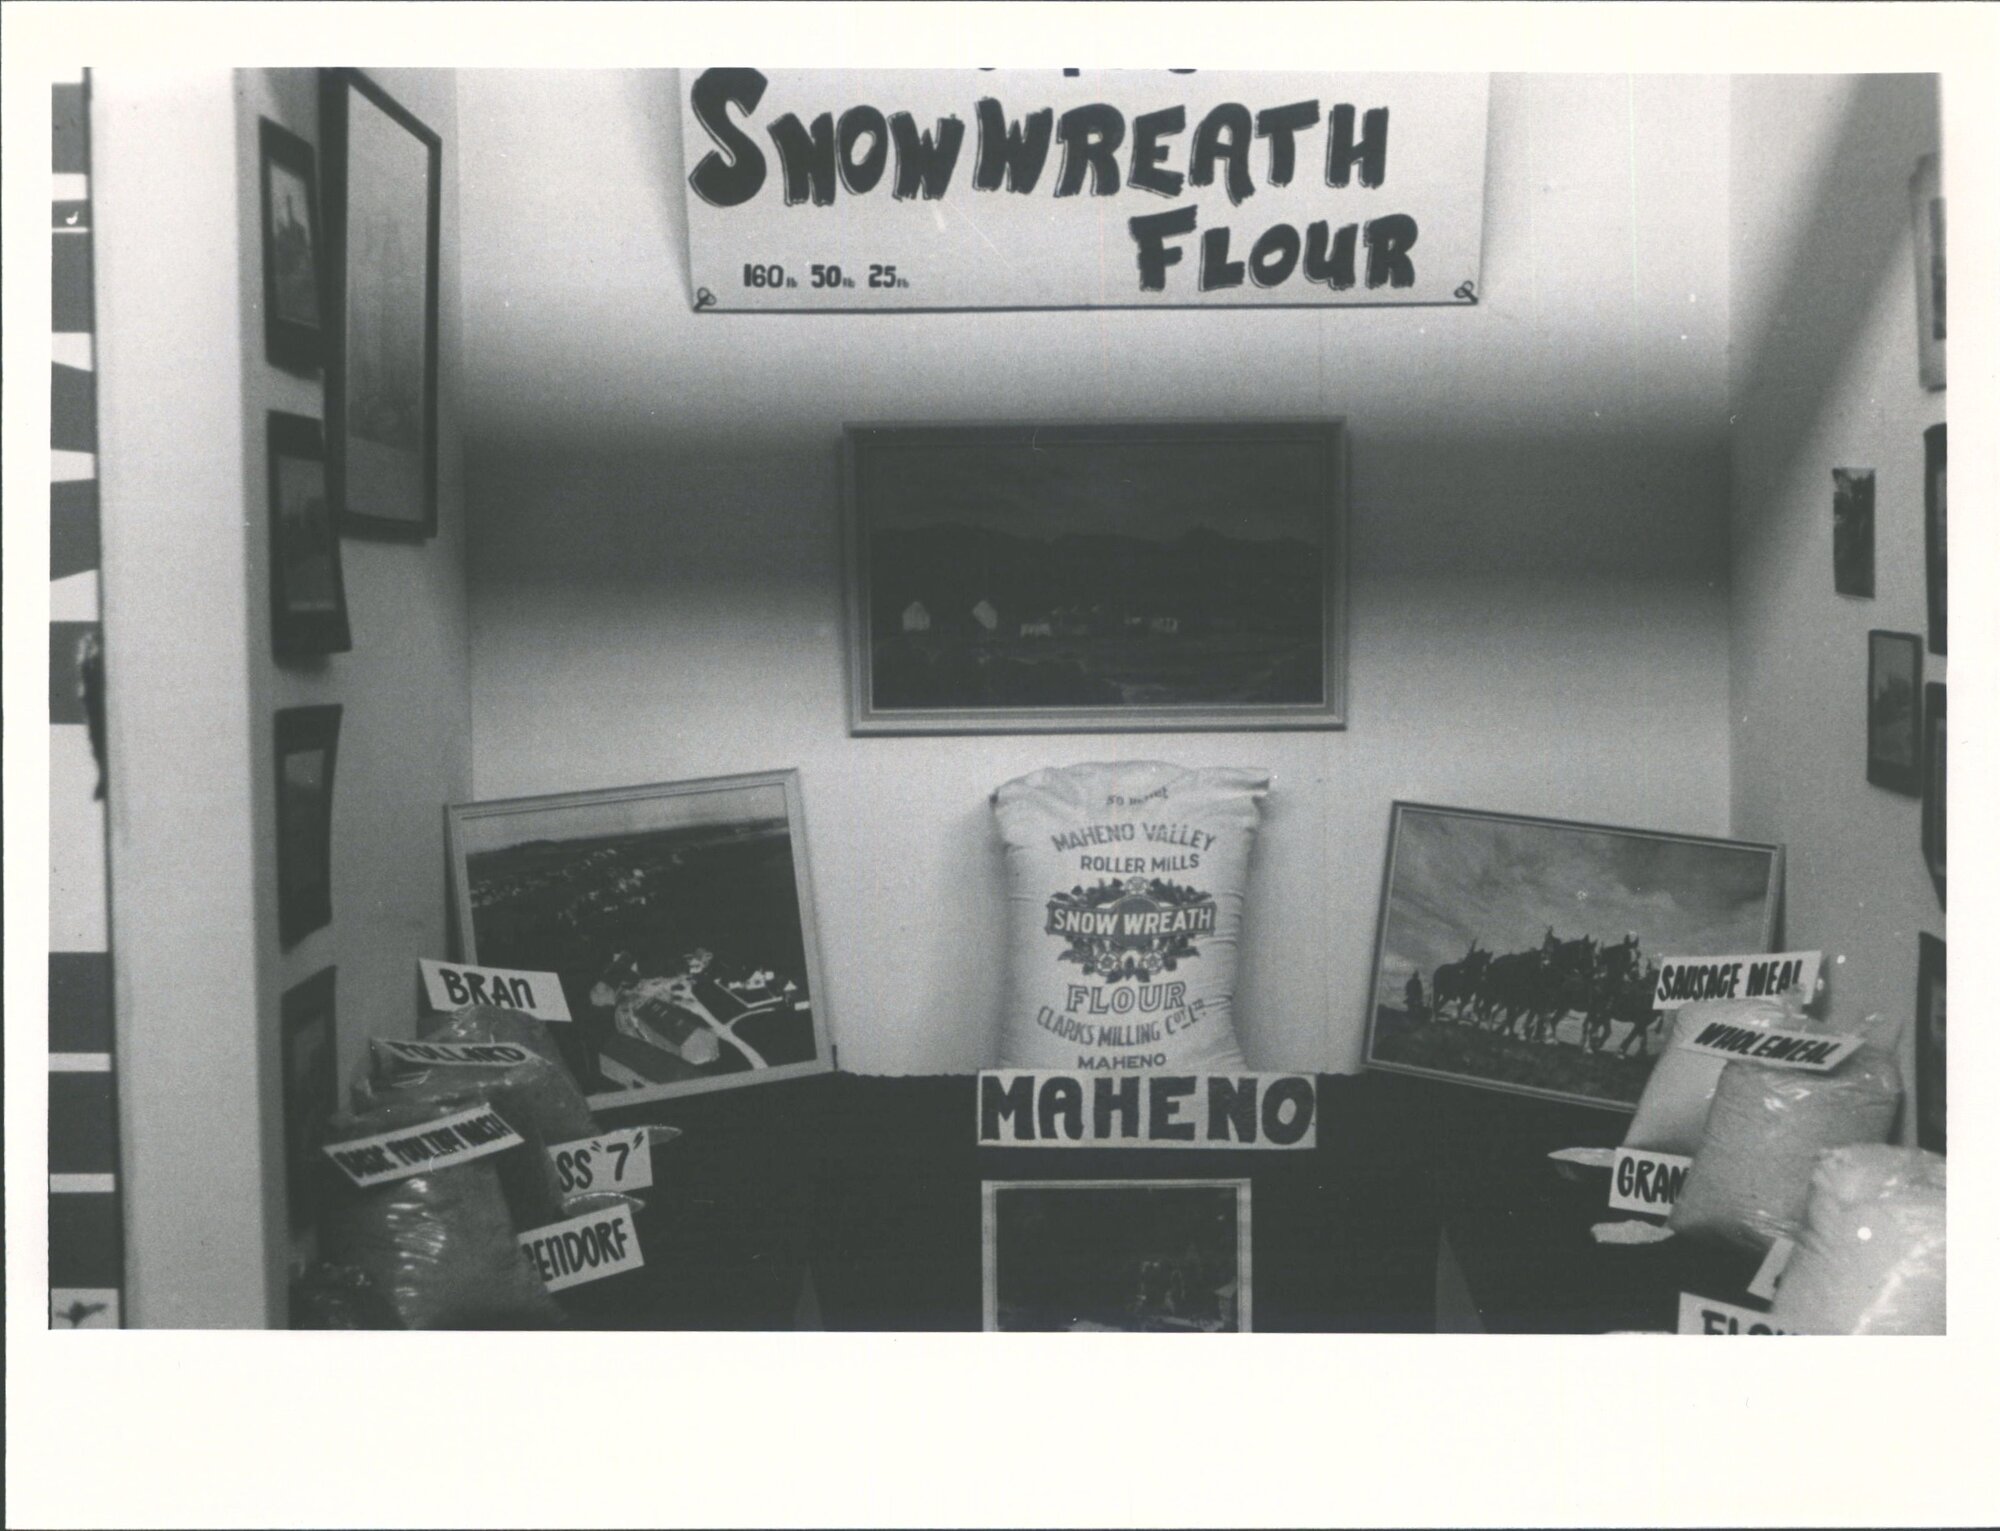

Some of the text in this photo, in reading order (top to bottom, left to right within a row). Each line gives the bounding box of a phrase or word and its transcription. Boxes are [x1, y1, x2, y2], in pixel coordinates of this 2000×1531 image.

[1128, 205, 1418, 292] FLOUR
[1051, 821, 1216, 852] MAHENO VALLEY
[1080, 853, 1200, 873] ROLLER MILLS
[1053, 907, 1212, 935] SNOW WREATH
[439, 968, 536, 1009] BRAN
[1066, 981, 1187, 1014] FLOUR
[1657, 964, 1744, 1002] SAUSAGE
[1098, 1021, 1161, 1047] MILLING
[1694, 1022, 1841, 1065] WHOLEMEAL
[1078, 1053, 1167, 1070] MAHENO
[980, 1075, 1315, 1145] MAHENO
